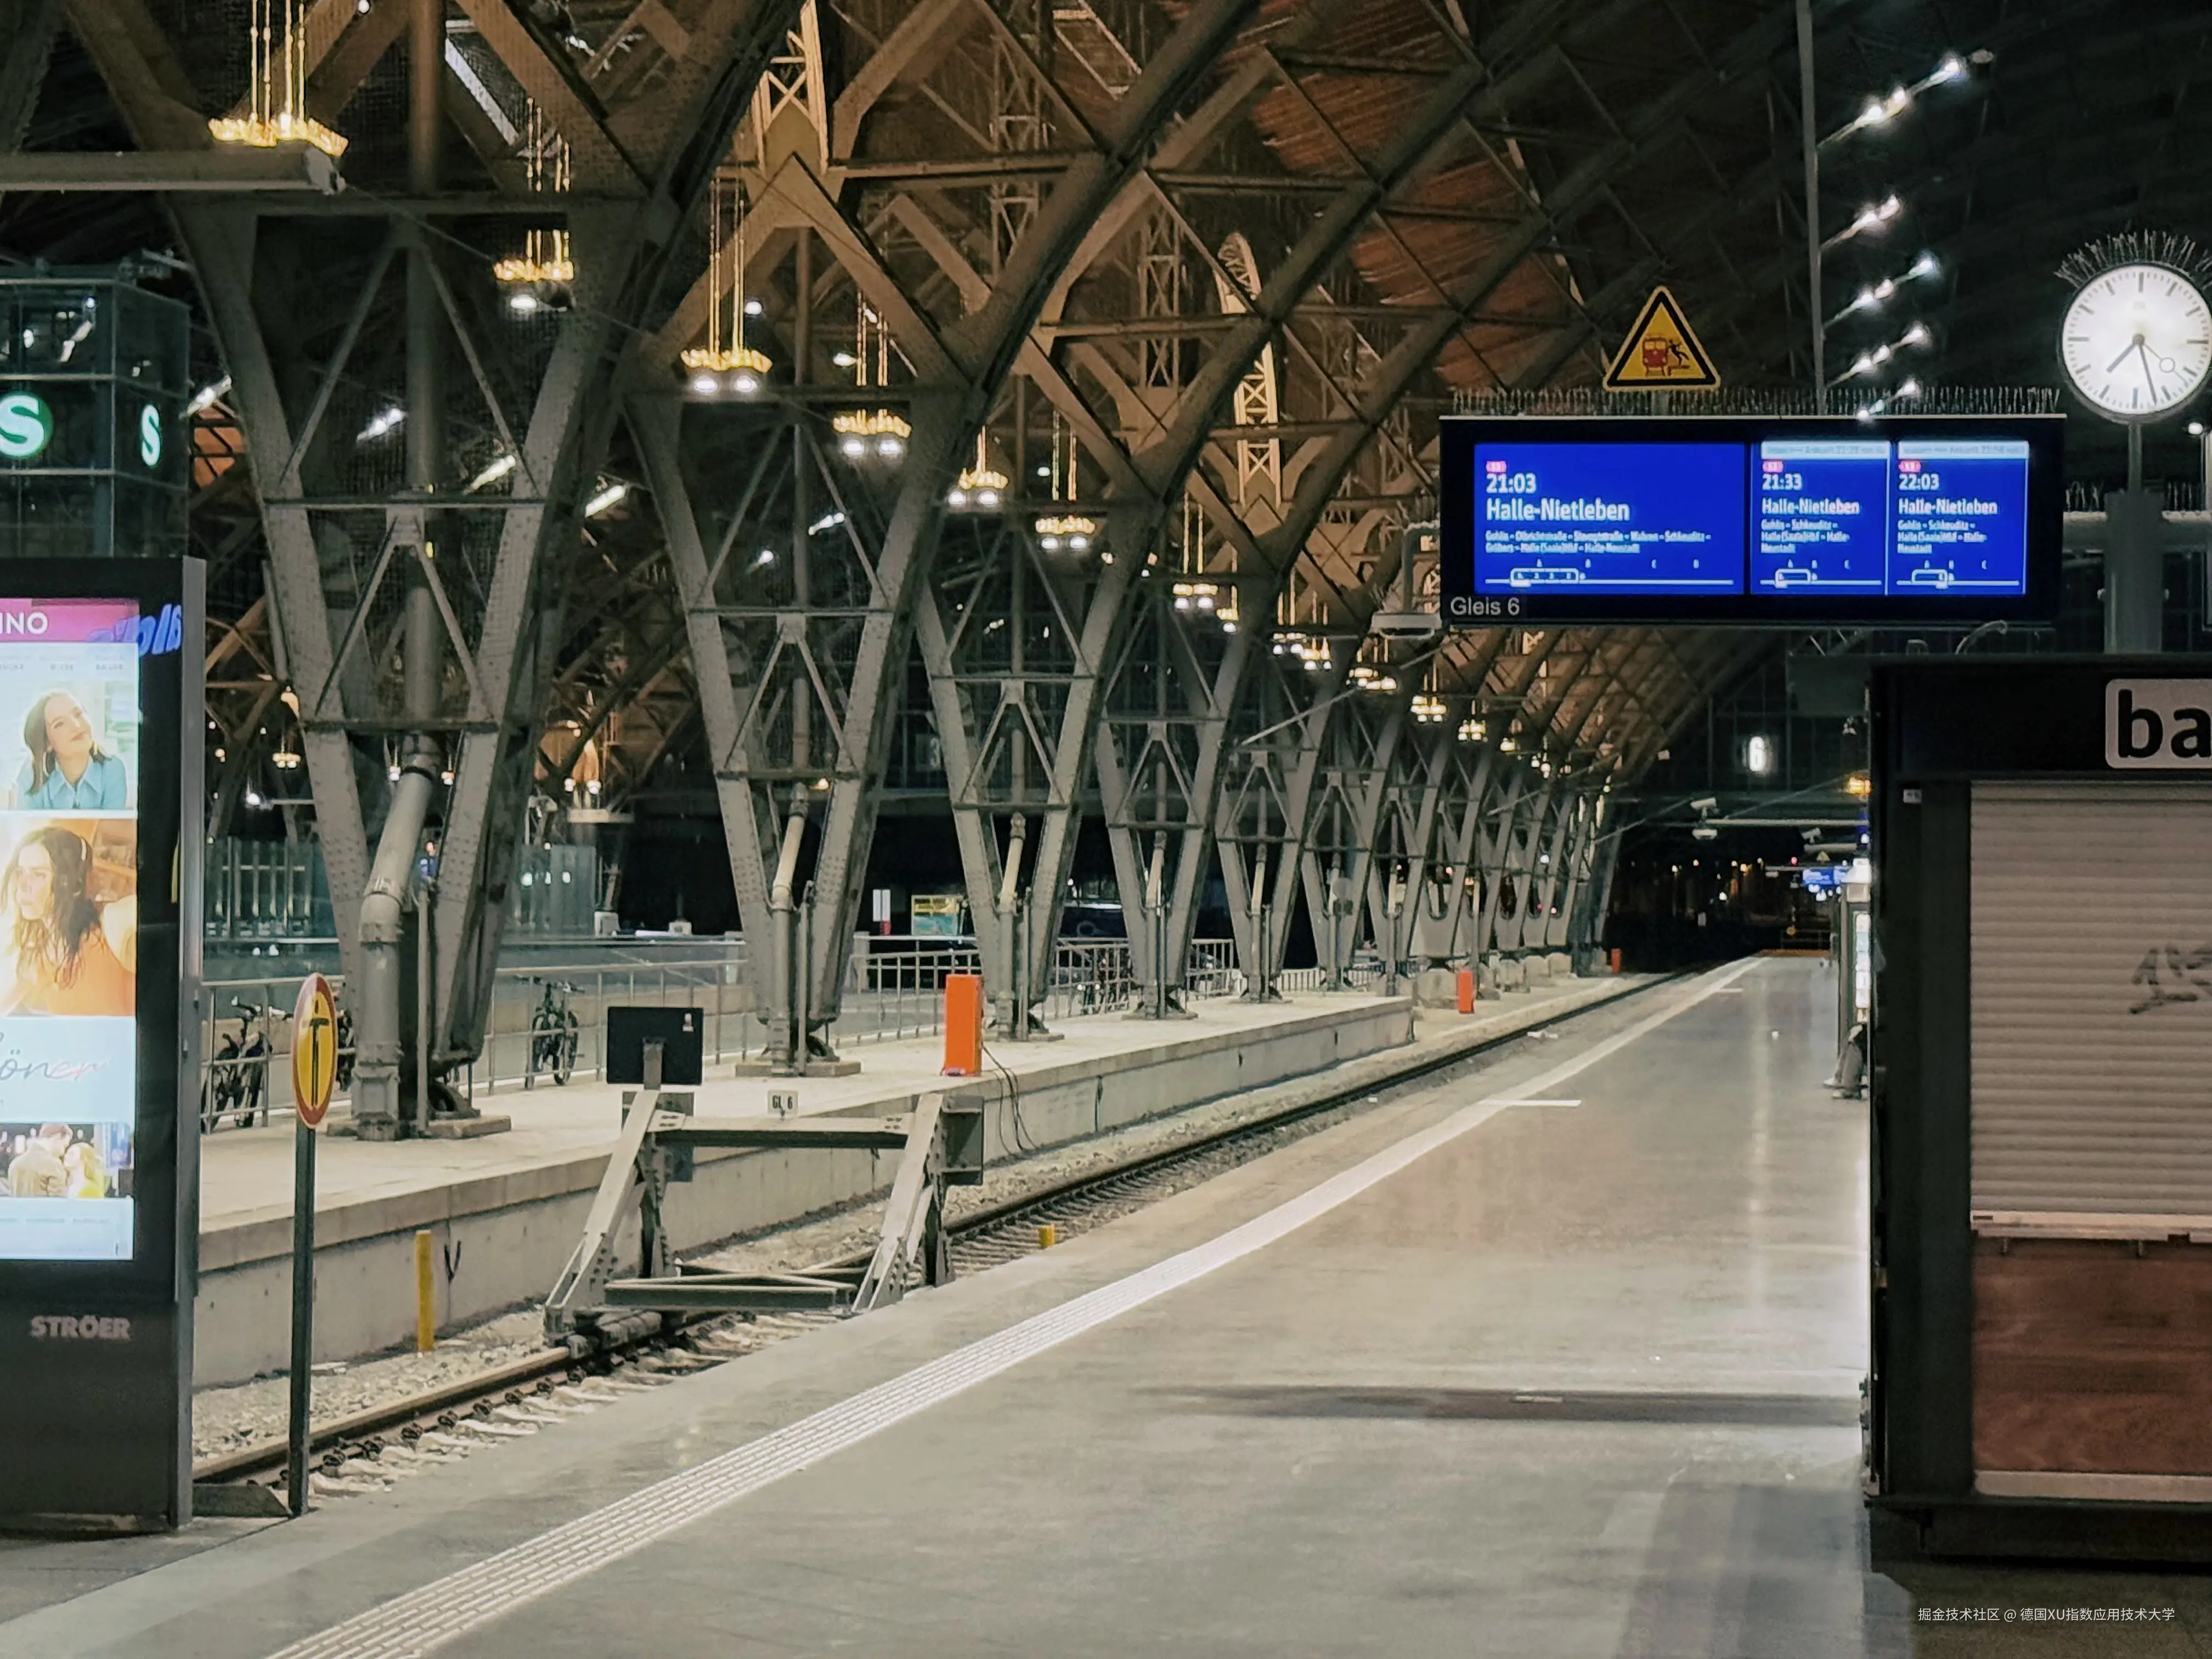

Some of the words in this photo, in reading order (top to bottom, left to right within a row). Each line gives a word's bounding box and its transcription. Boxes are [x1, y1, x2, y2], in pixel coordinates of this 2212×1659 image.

[0, 394, 44, 456] S
[142, 405, 161, 466] S
[1486, 473, 1536, 494] 21:03
[1762, 473, 1802, 490] 21:33
[1899, 473, 1939, 490] 22:03
[1486, 498, 1630, 521] Halle-Nietleben
[1762, 498, 1860, 515] Halle-Nietleben
[1899, 498, 1998, 515] Halle-Nietleben
[1450, 596, 1501, 615] Gleis
[1507, 596, 1520, 615] 6
[2118, 689, 2211, 758] ba
[31, 1315, 130, 1340] STRÖER
